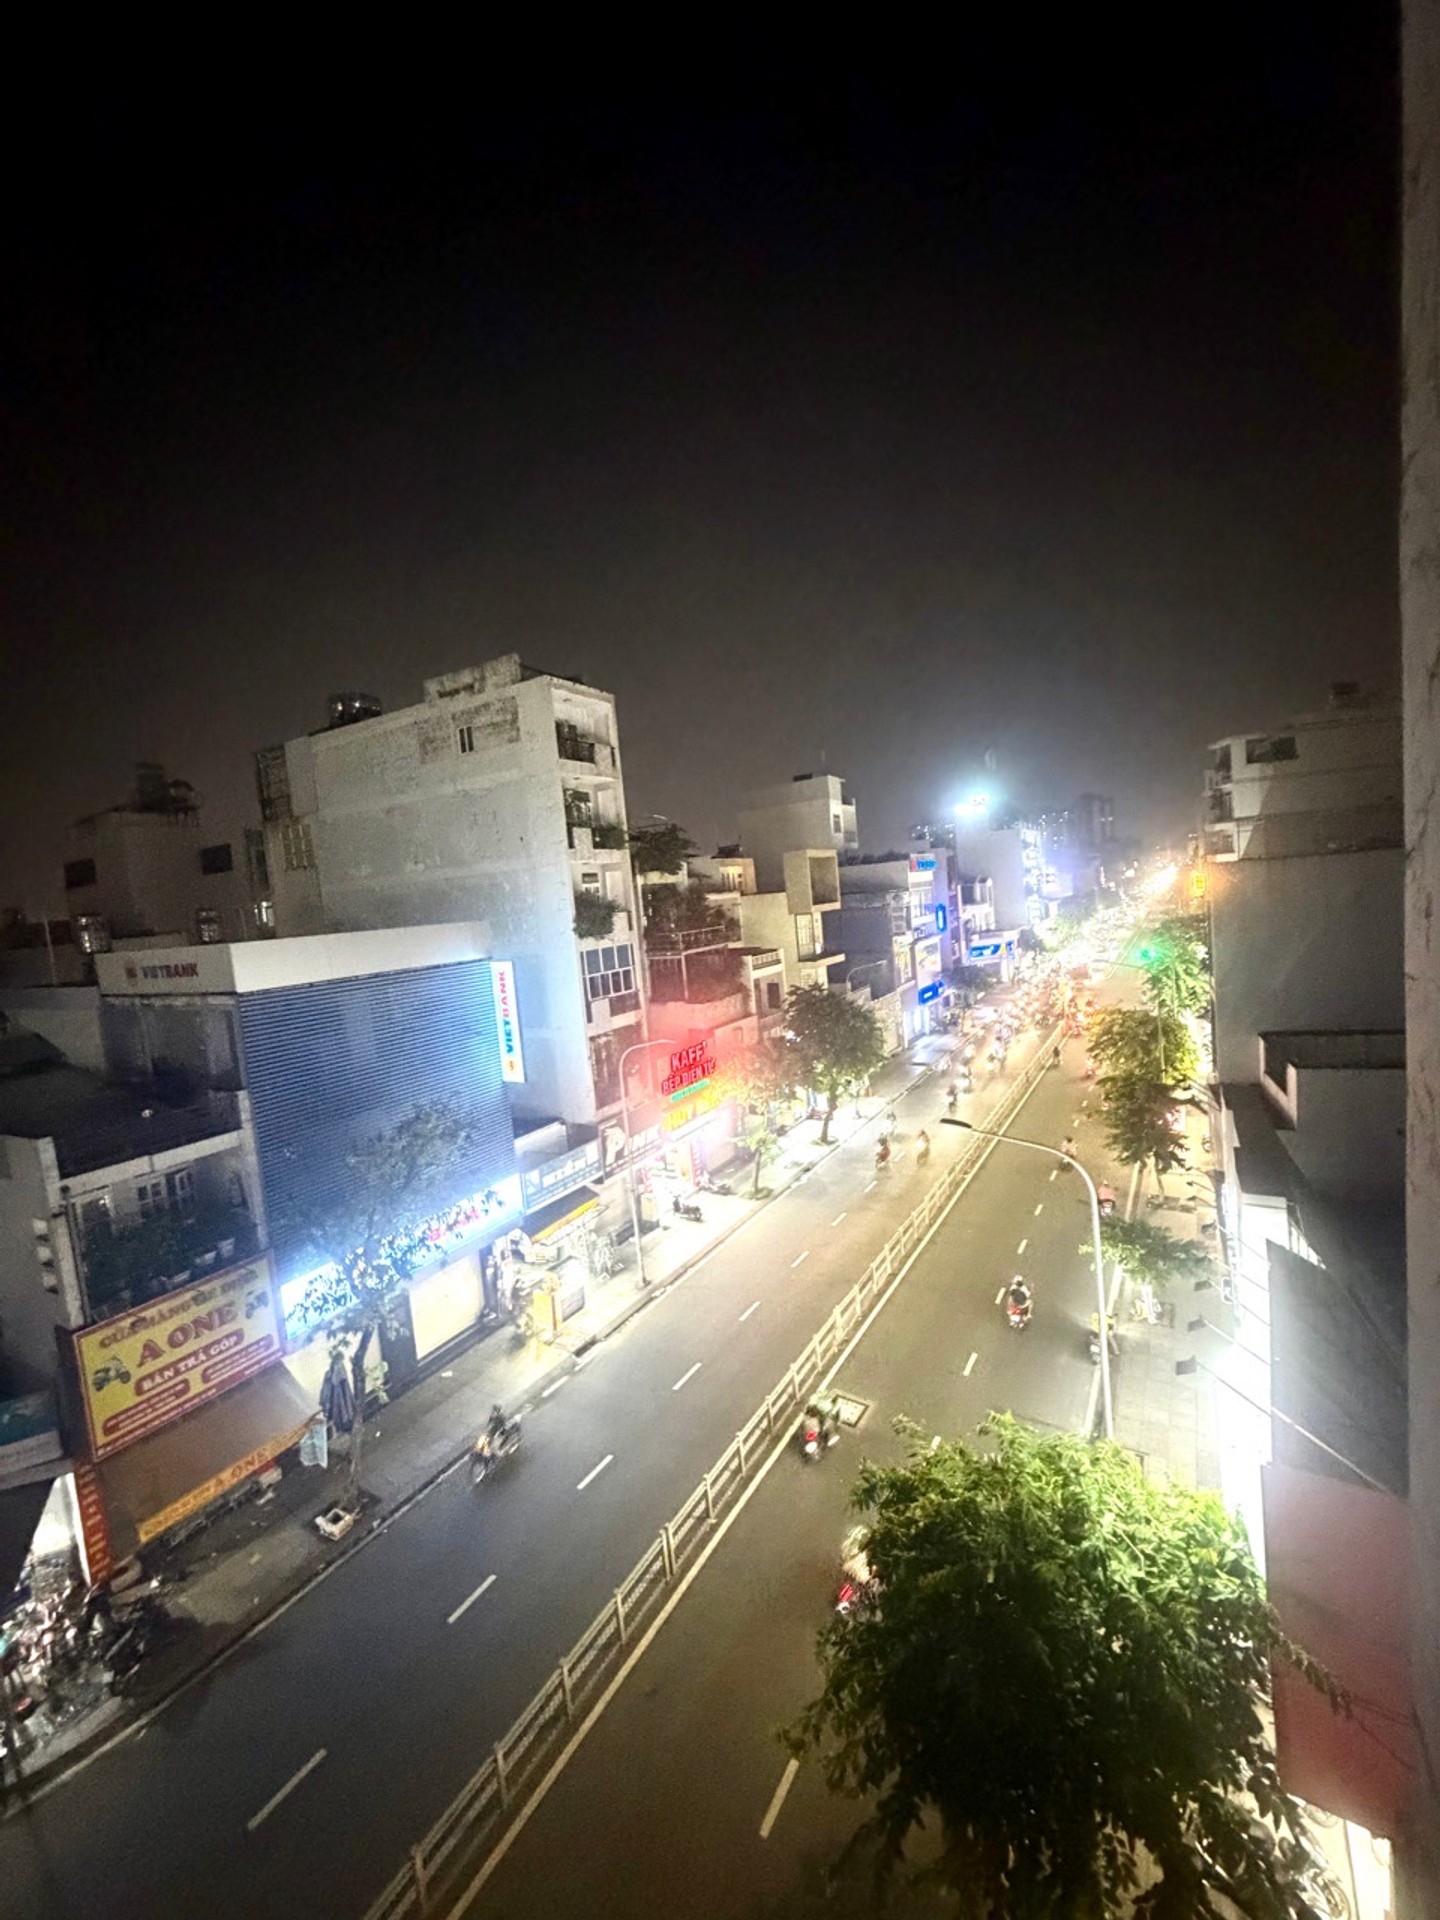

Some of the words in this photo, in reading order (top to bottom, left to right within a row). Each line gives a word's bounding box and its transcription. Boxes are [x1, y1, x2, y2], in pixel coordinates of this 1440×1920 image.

[141, 963, 199, 978] VIETBANK
[498, 971, 514, 1054] VIETBANK
[136, 1339, 166, 1368] A
[167, 1301, 239, 1349] ONE
[142, 1368, 175, 1391] BÁN
[210, 1334, 239, 1356] GÓP
